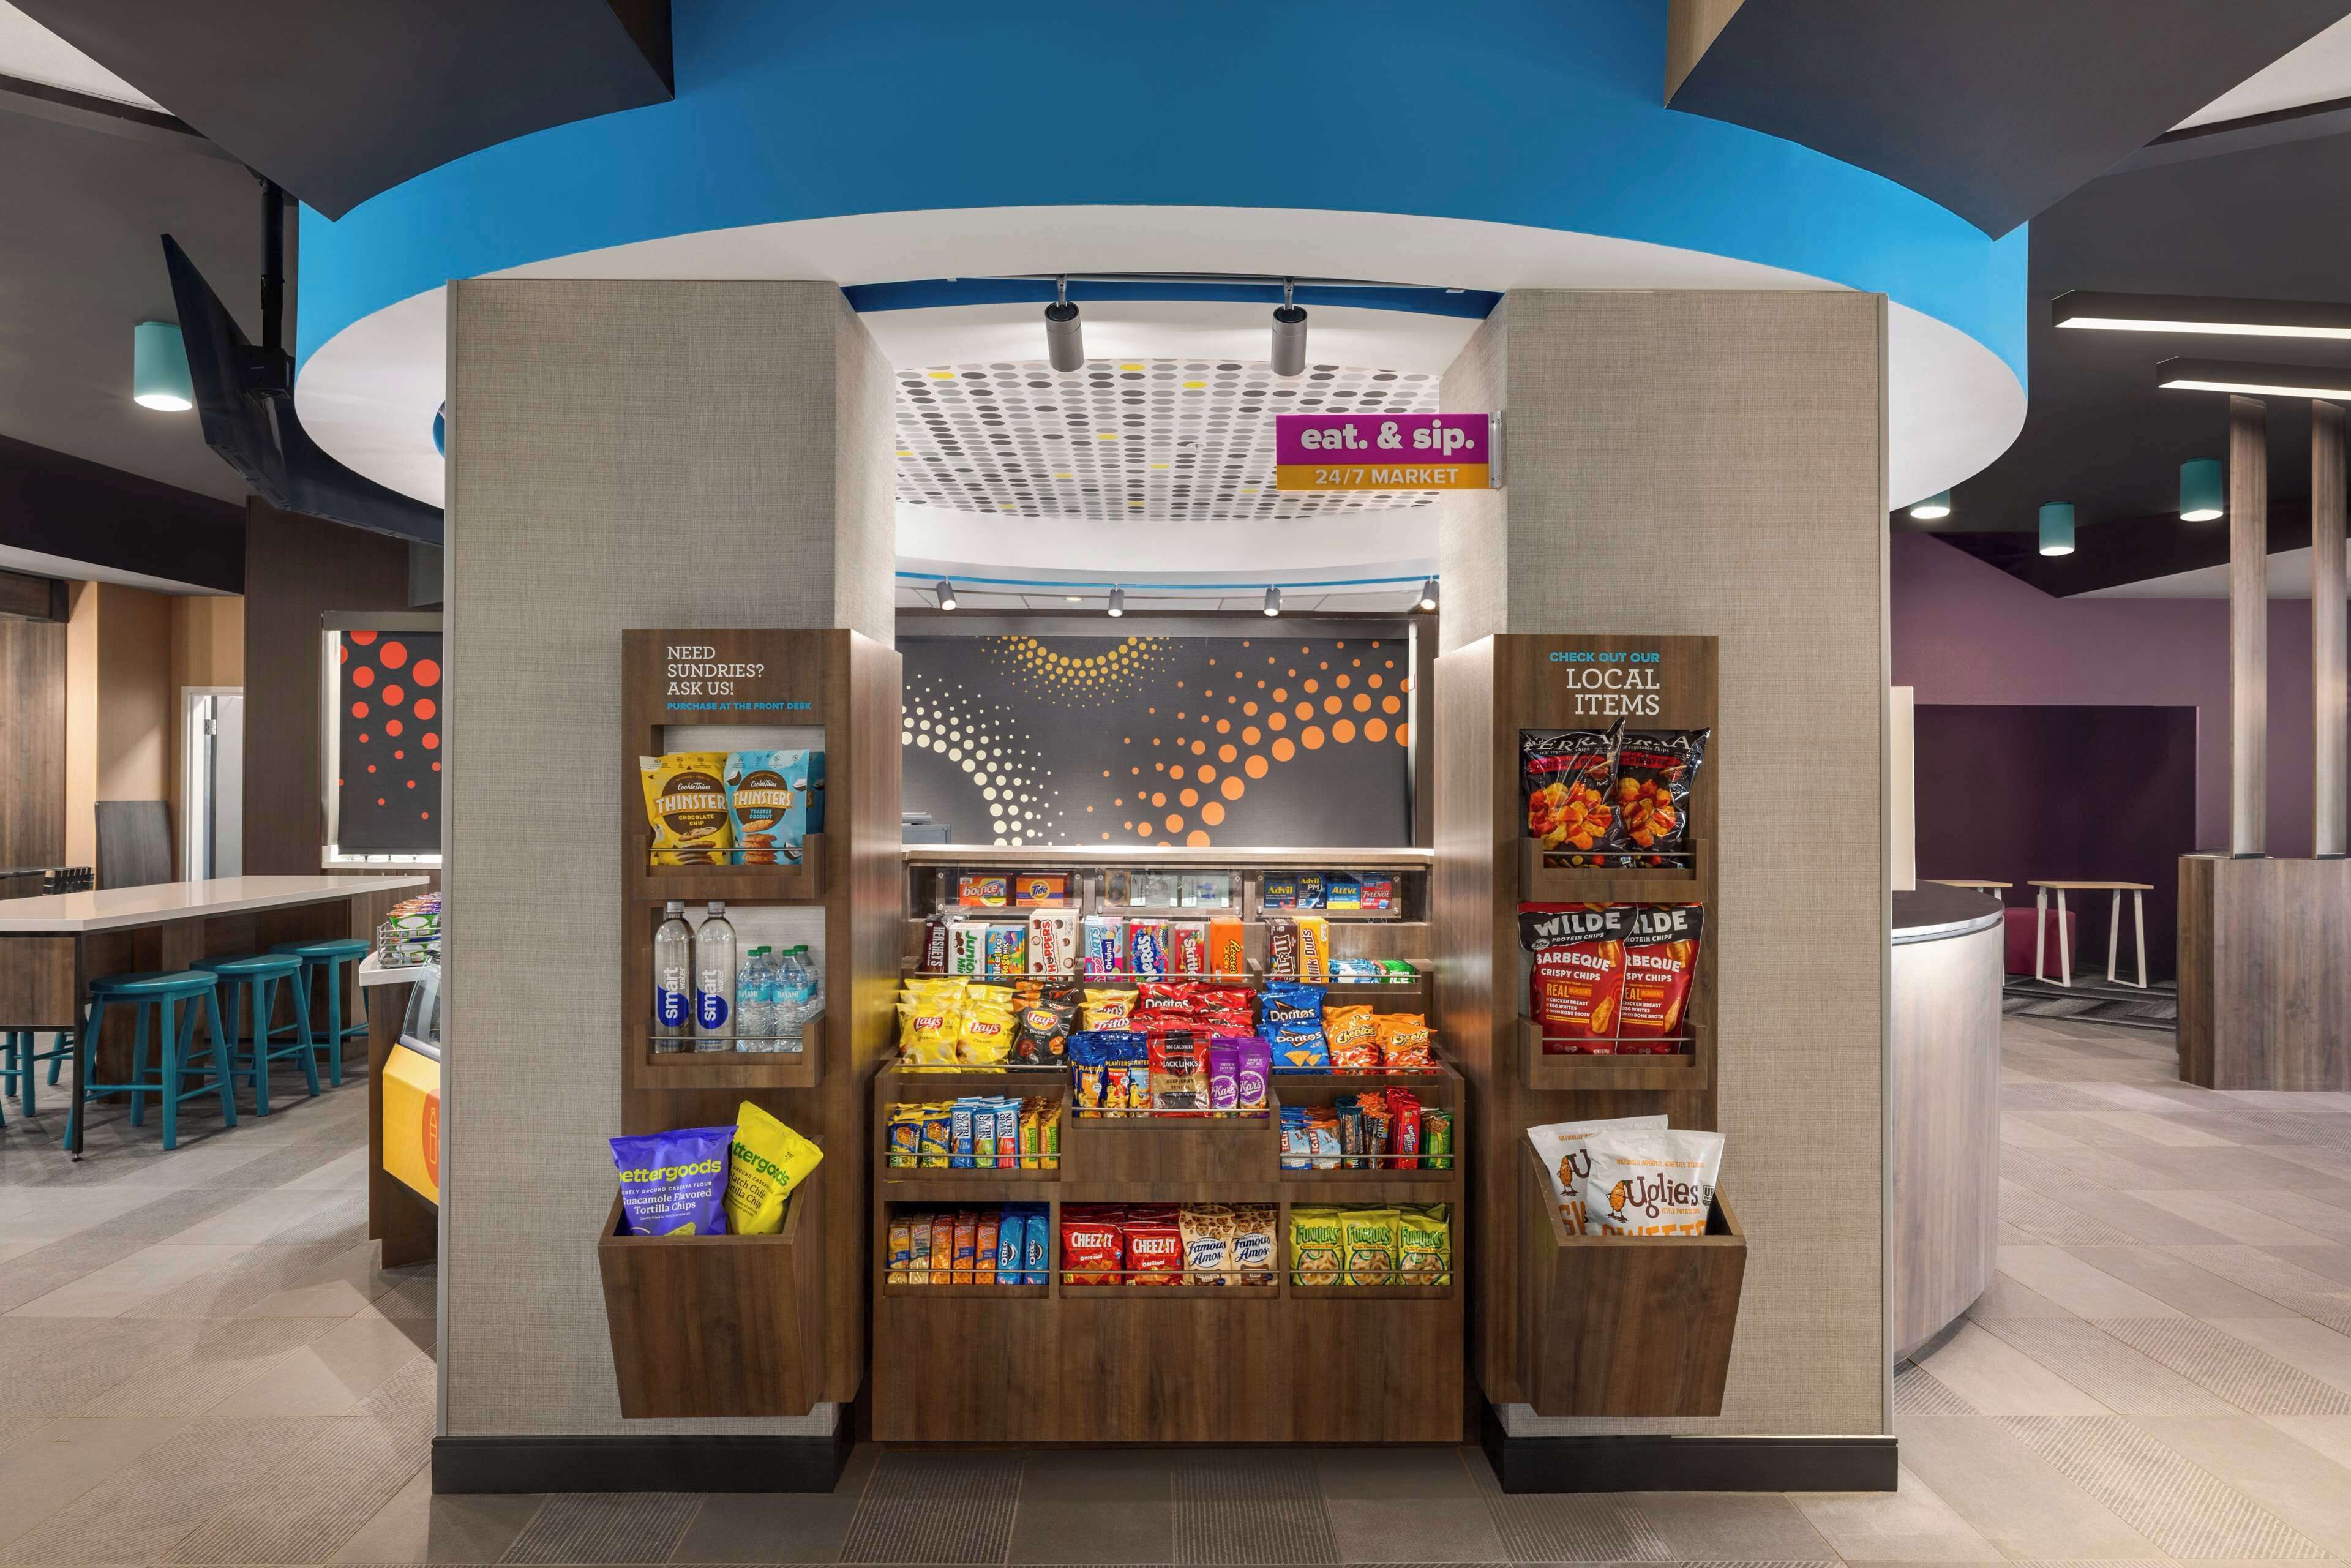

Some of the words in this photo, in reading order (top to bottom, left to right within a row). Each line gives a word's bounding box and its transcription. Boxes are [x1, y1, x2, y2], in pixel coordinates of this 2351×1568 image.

[1301, 424, 1368, 449] eat.
[1377, 421, 1403, 449] &
[1412, 419, 1475, 456] sip.
[1315, 469, 1365, 485] 24/7
[1371, 468, 1460, 484] MARKET
[667, 646, 715, 659] NEED
[1549, 651, 1595, 662] CHECK
[1599, 652, 1627, 662] OUT
[1630, 652, 1660, 662] OUR
[667, 664, 765, 678] SUNDRIES?
[1566, 668, 1660, 689] LOCAL
[667, 681, 703, 696] ASK
[707, 681, 734, 696] US!
[1575, 694, 1660, 715] ITEMS
[656, 794, 726, 814] THINSTER
[733, 790, 791, 807] THINSTERS
[963, 883, 999, 897] bounce
[1032, 885, 1048, 896] Tide
[1534, 912, 1621, 936] WILDE
[931, 927, 945, 967] HERSHEY'S
[1302, 929, 1317, 956] Duds
[1536, 952, 1611, 972] BARBEQUE
[1627, 955, 1681, 973] RBEQUE
[716, 969, 725, 993] water
[1541, 968, 1572, 978] CRISPY
[1573, 972, 1601, 981] CHIPS
[664, 967, 678, 1019] smart
[702, 969, 717, 1021] smart
[738, 990, 758, 999] DASANI
[778, 989, 799, 999] DASANI
[1547, 983, 1569, 997] REAL
[1625, 988, 1642, 1000] EAL
[1146, 999, 1188, 1008] Doritos
[1029, 1013, 1057, 1026] Lay's
[1270, 1008, 1315, 1021] Doritos
[916, 1016, 942, 1031] Lay's
[970, 1020, 1000, 1034] Lay's
[1276, 1032, 1322, 1043] Doritos
[1336, 1026, 1375, 1044] Cheetos
[1406, 1125, 1416, 1144] Nutter
[1404, 1134, 1413, 1152] Butter
[732, 1141, 790, 1186] ttergoods
[733, 1165, 752, 1179] GROUND
[674, 1188, 711, 1201] Flavored
[1626, 1172, 1698, 1218] Uglies
[634, 1204, 670, 1215] Tortilla
[672, 1201, 696, 1212] Chips
[1185, 1240, 1226, 1257] Famous
[1230, 1234, 1271, 1253] Famous
[1188, 1251, 1223, 1267] Amos
[1234, 1247, 1270, 1262] Amos
